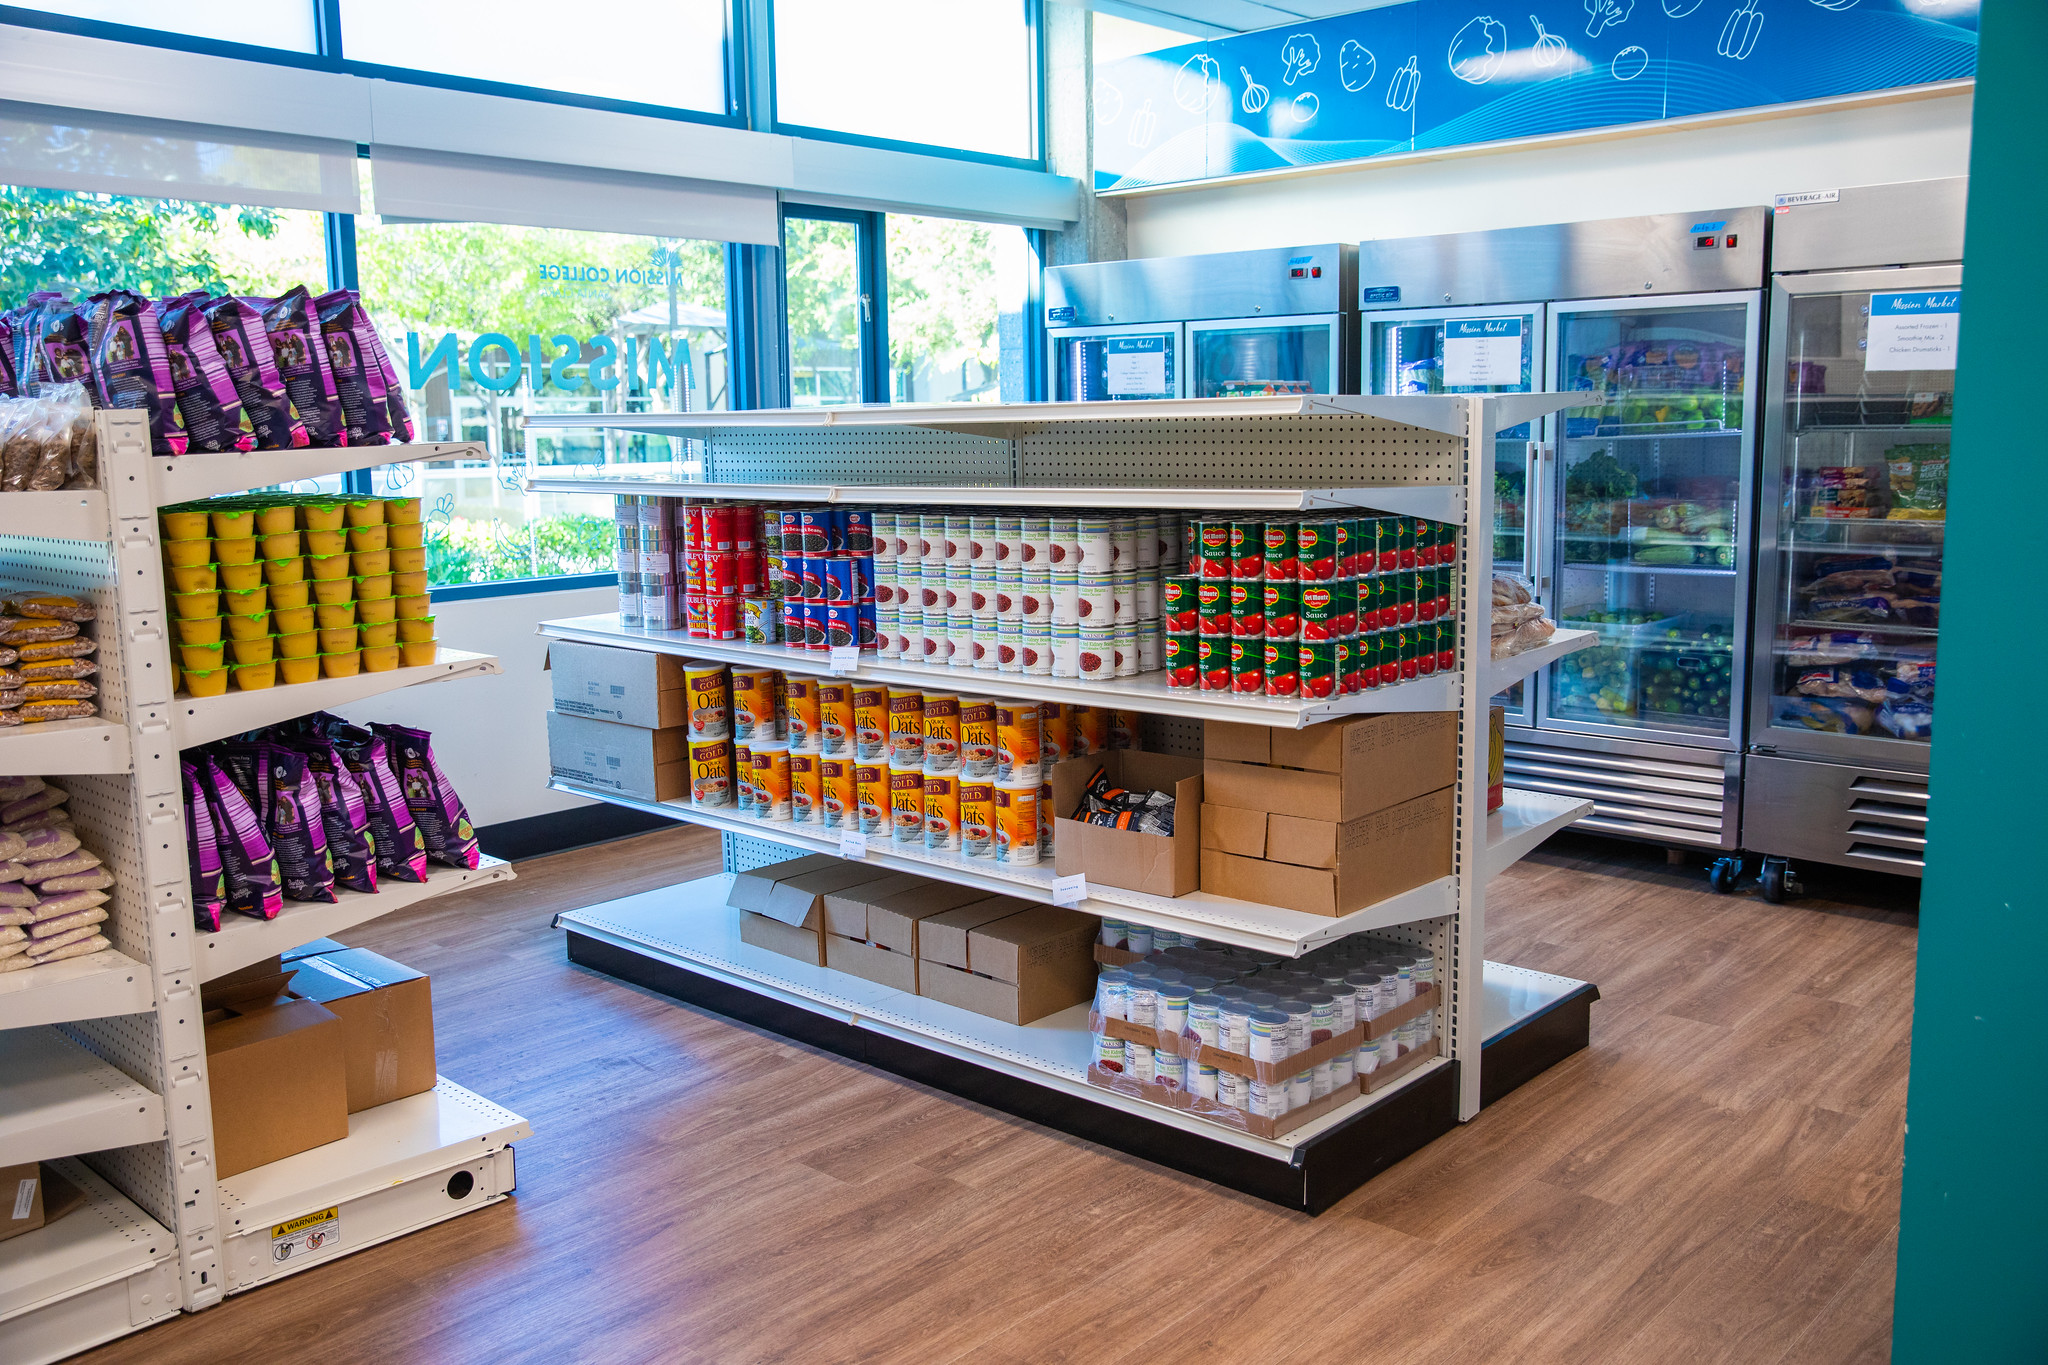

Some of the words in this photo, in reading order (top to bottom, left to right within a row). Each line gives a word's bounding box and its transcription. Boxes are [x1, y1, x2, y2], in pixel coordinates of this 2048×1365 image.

[1787, 193, 1836, 203] BEVERAGE-AIR
[1891, 298, 1921, 310] Mission
[1924, 296, 1957, 308] Market
[1459, 323, 1481, 333] Mission
[1484, 322, 1508, 333] Market
[1204, 549, 1226, 557] Sauce
[1265, 551, 1283, 559] Sauce
[700, 678, 722, 690] GOLD
[697, 693, 725, 710] Oats
[820, 693, 834, 701] OLD
[735, 698, 749, 712] ats
[892, 702, 918, 712] GOLD
[925, 706, 950, 716] GOLD
[822, 711, 839, 726] ats
[855, 711, 877, 730] ats
[961, 711, 987, 722] GOLD
[1106, 714, 1126, 728] ats
[891, 715, 920, 734] Oats
[924, 720, 952, 740] Oats
[961, 726, 991, 745] Oats
[700, 748, 723, 760] GOLD
[697, 763, 726, 780] Oats
[737, 769, 750, 784] ats
[857, 773, 872, 781] OLD
[752, 777, 766, 791] ats
[792, 780, 806, 794] ats
[925, 784, 941, 793] OLD
[823, 784, 837, 799] ats
[859, 790, 875, 806] ats
[925, 801, 944, 819] ats
[287, 1214, 324, 1230] WARNING
